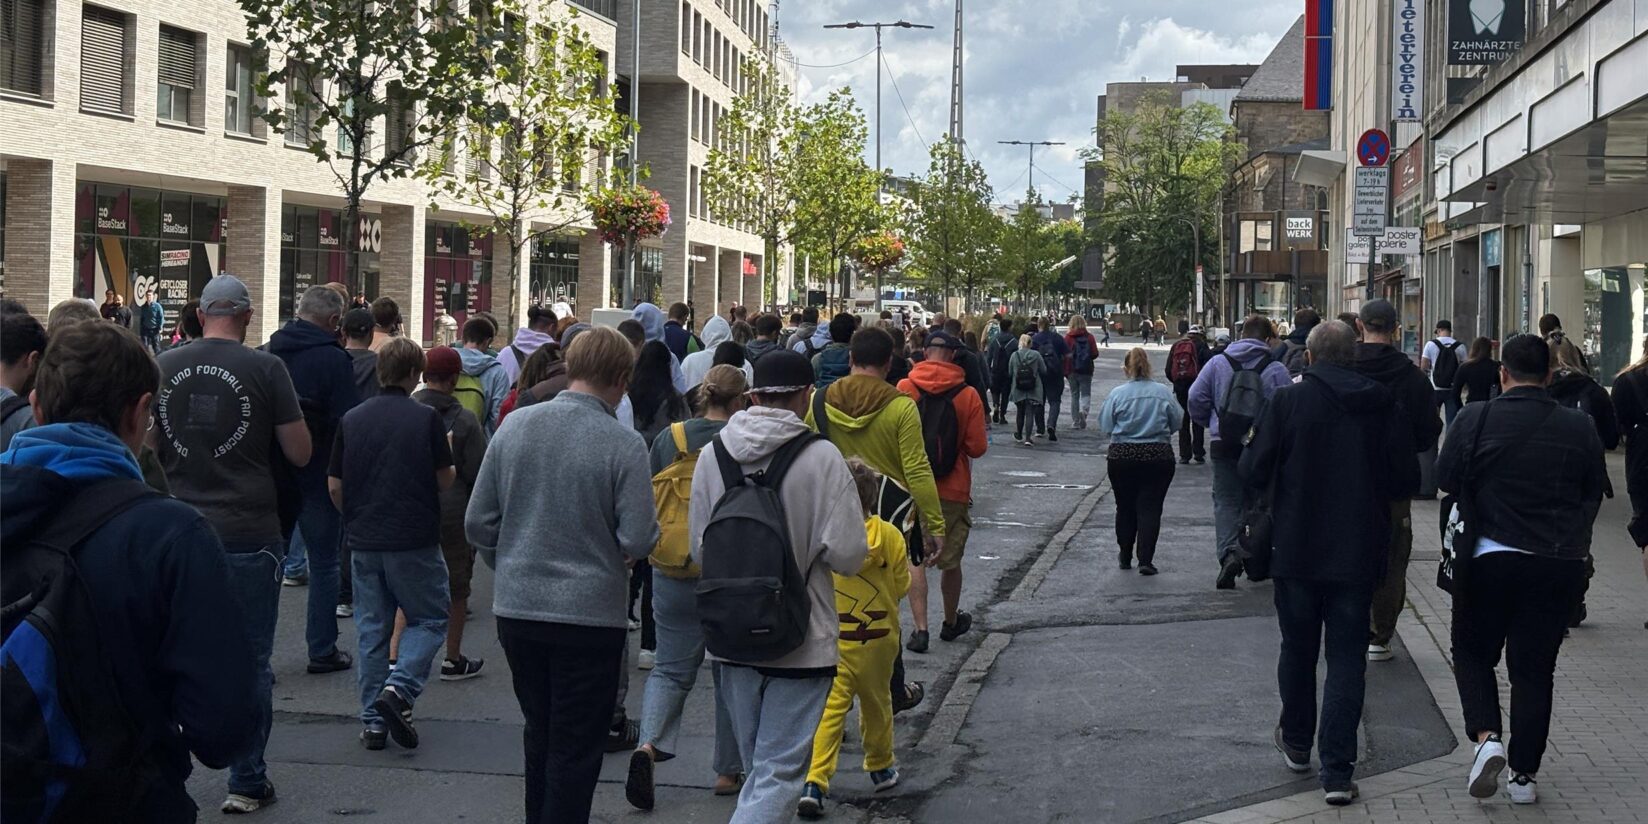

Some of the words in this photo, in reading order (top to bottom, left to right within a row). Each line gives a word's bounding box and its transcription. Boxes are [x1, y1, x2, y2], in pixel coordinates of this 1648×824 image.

[1452, 39, 1521, 50] ZAHNÄRZTE
[1358, 169, 1386, 178] werktags
[98, 218, 127, 230] BaseStack
[1287, 219, 1312, 228] back
[162, 224, 188, 234] BaseStack
[1286, 230, 1313, 238] WERK
[1387, 230, 1418, 243] poster
[1348, 240, 1370, 250] galeri
[1374, 240, 1407, 250] galerie
[167, 289, 188, 299] RACING
[170, 367, 192, 386] UND
[196, 365, 243, 394] FOOTBALL
[239, 395, 251, 417] FAN
[214, 420, 250, 459] PODCAST
